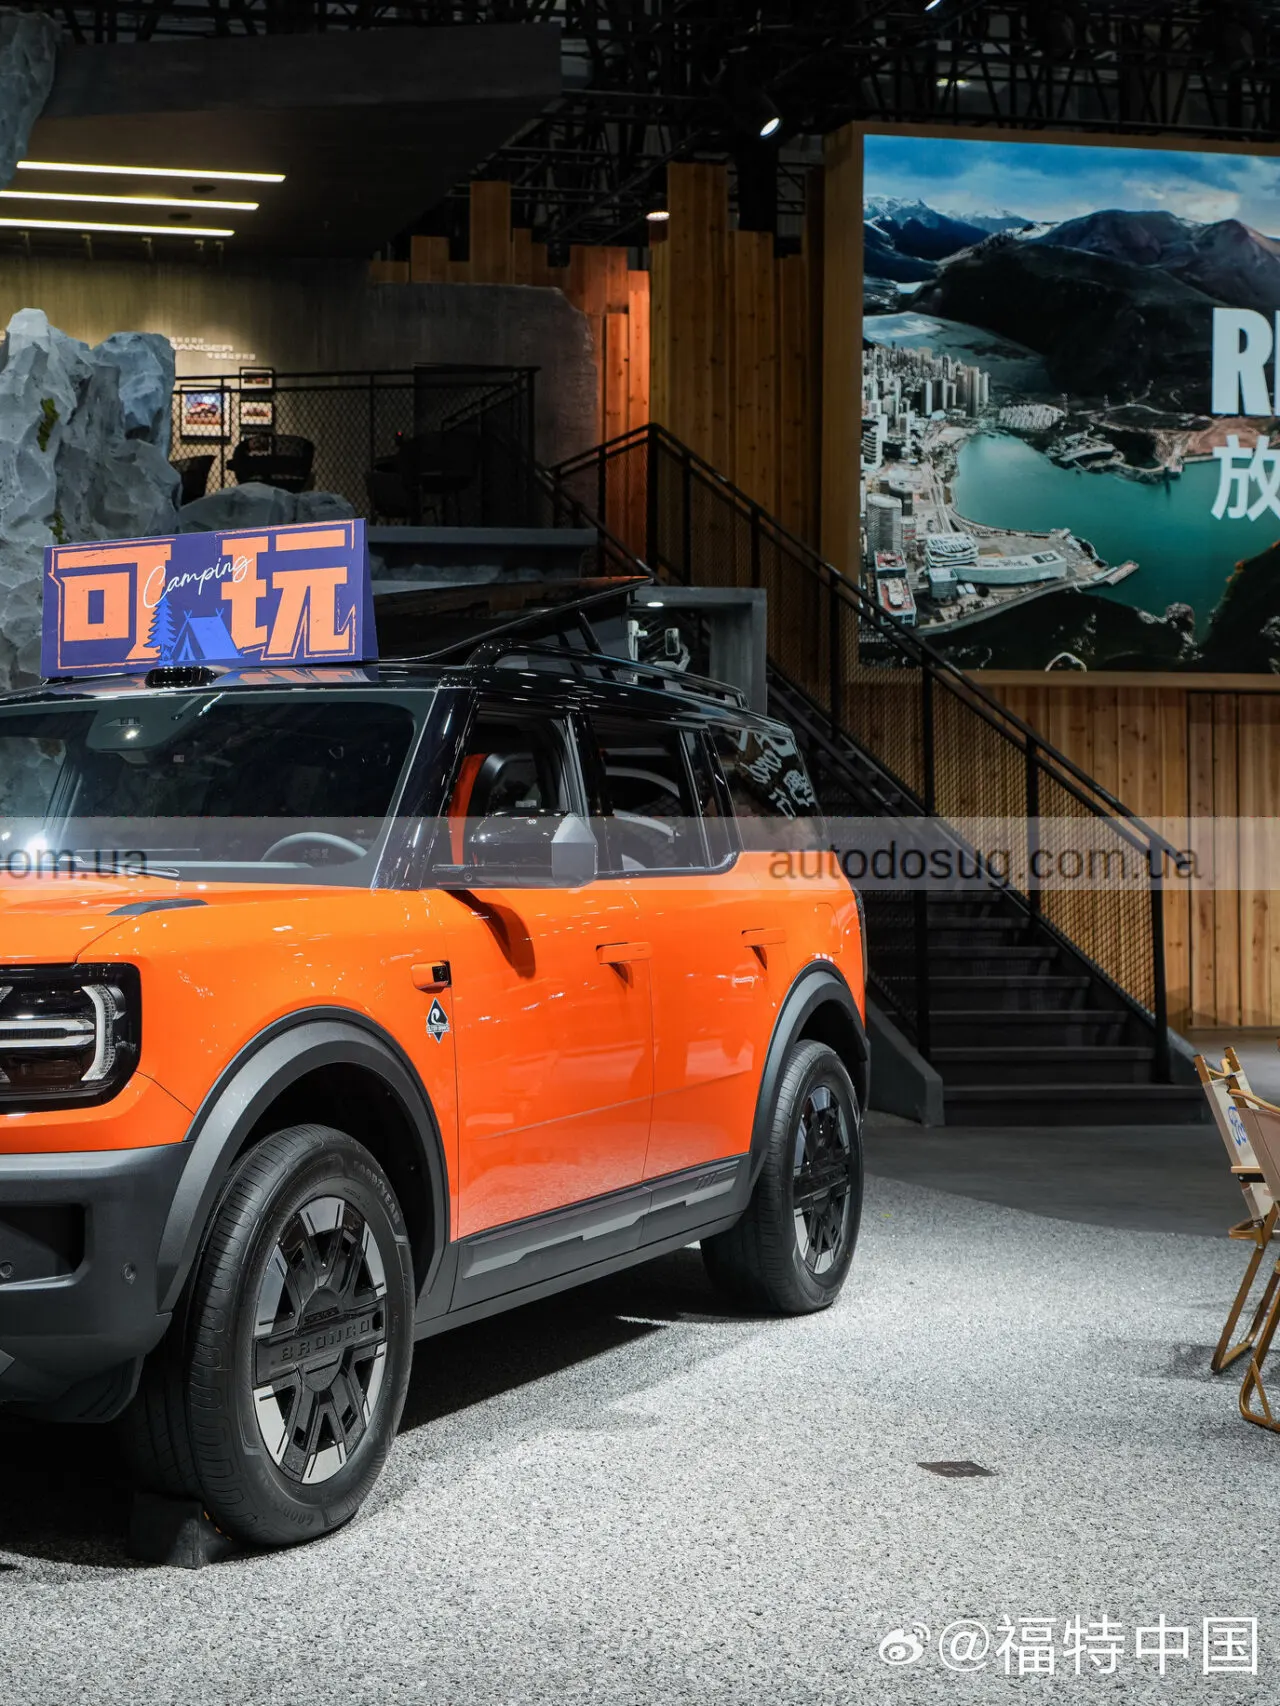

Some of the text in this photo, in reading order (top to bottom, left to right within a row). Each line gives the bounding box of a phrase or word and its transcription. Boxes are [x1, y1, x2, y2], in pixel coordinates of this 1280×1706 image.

[1210, 434, 1280, 522] 放
[57, 528, 348, 661] 可玩
[142, 555, 254, 609] Camping
[281, 1319, 370, 1361] BRONCO
